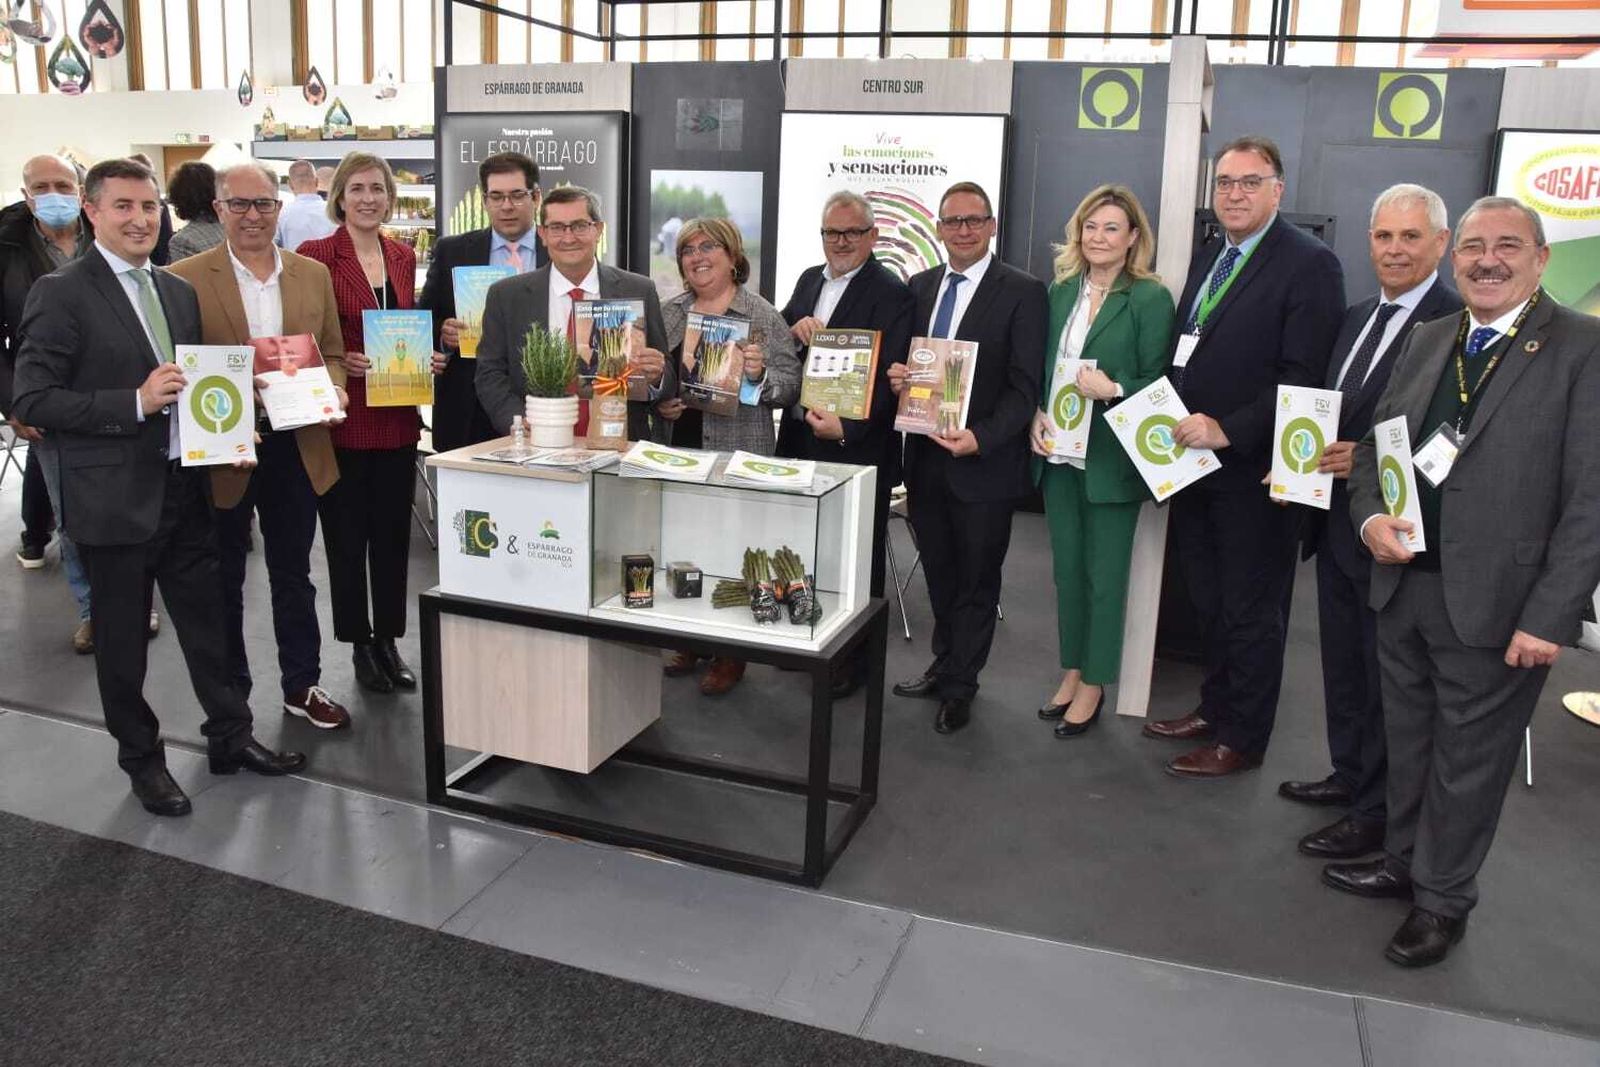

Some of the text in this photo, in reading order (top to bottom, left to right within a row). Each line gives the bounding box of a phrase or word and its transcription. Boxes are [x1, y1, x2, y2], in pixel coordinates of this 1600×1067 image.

[484, 81, 584, 95] ESPÁRRAGO DE GRANADA
[862, 79, 924, 94] CENTRO SUR
[460, 141, 479, 163] EL
[842, 145, 934, 159] las emociones
[827, 159, 948, 178] y sensaciones
[1533, 165, 1600, 201] COSAF
